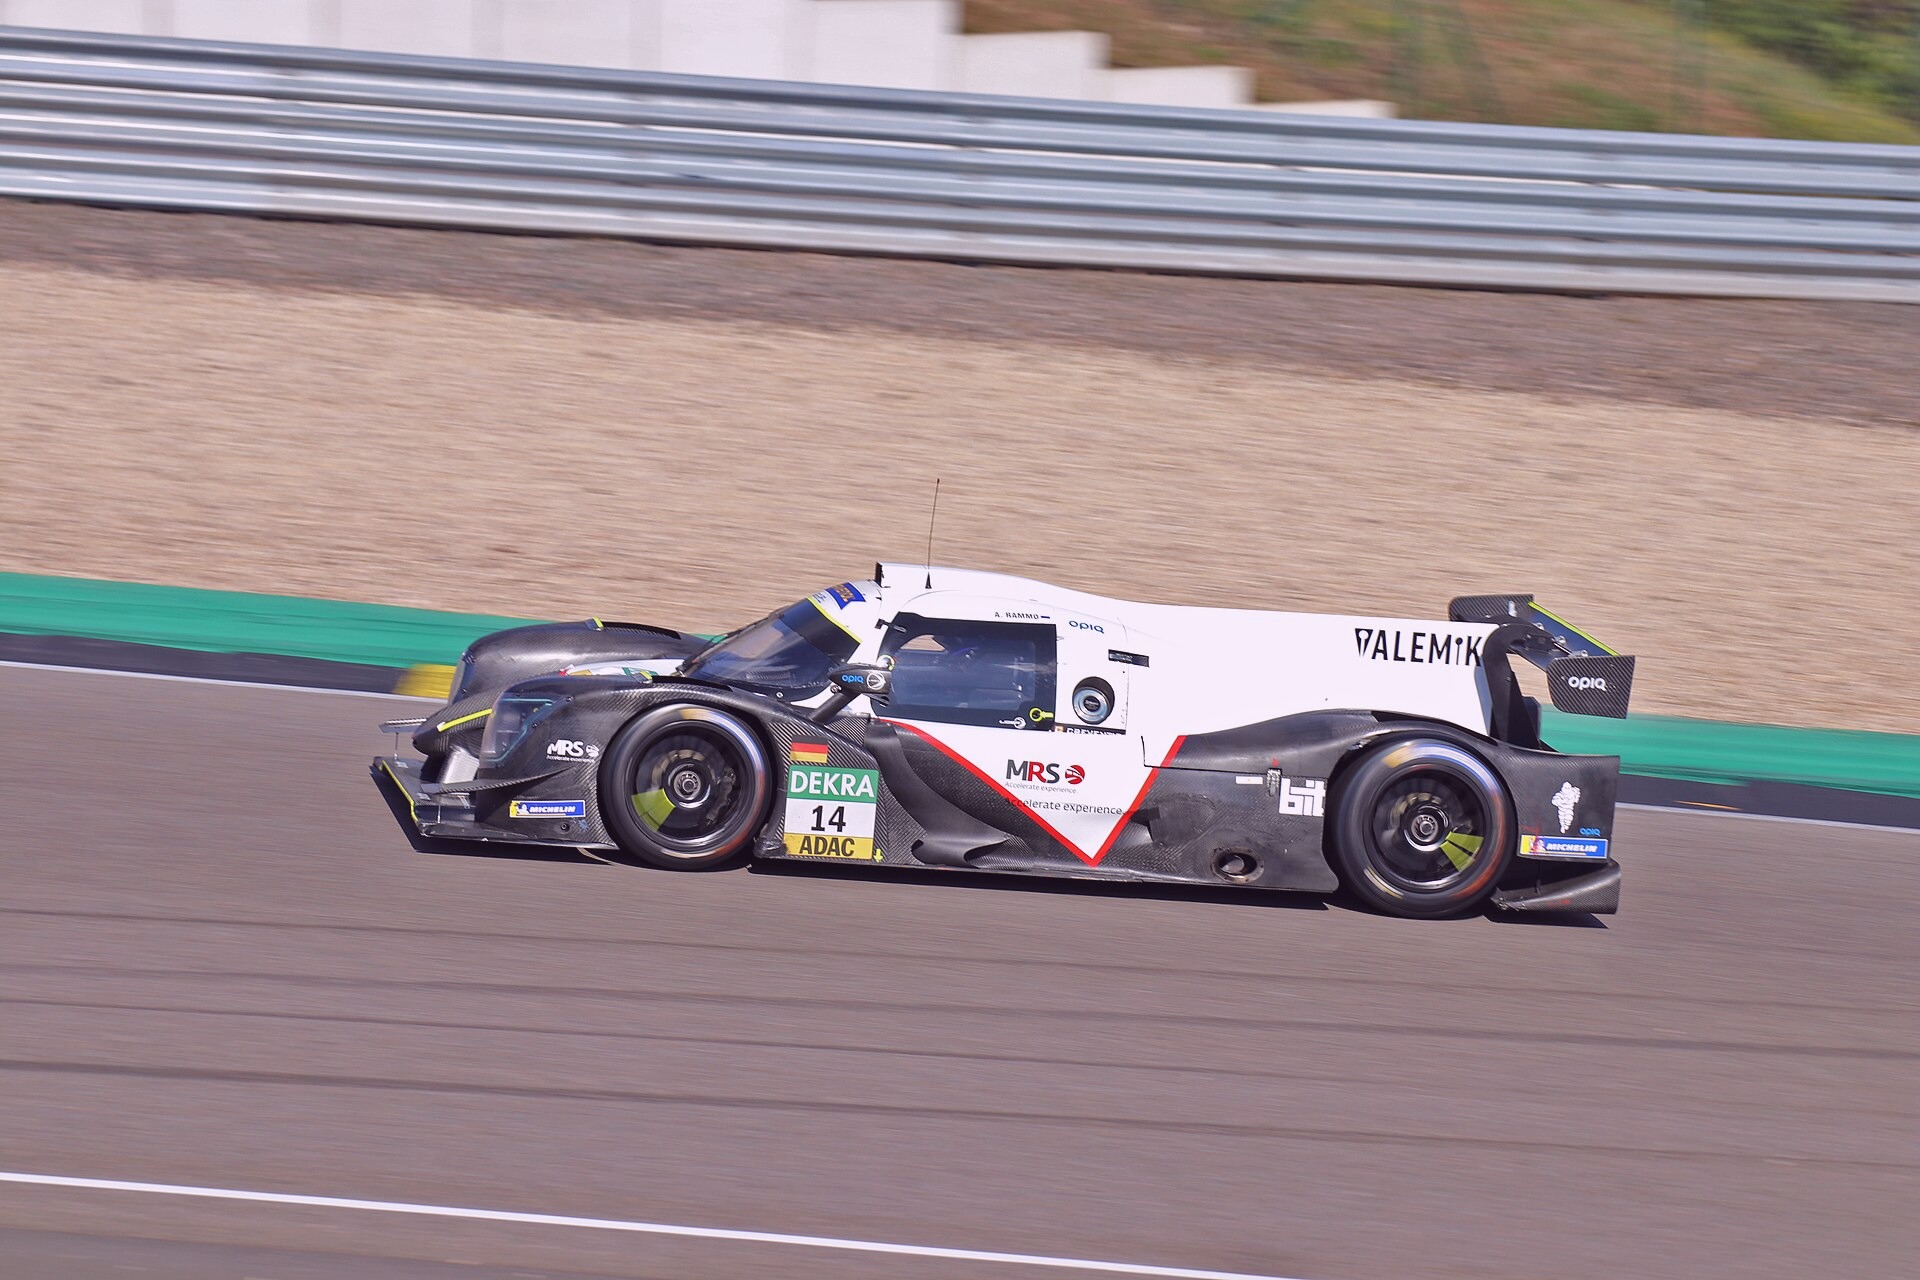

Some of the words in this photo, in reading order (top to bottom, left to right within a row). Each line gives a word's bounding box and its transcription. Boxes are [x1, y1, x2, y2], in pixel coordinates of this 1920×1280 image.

[546, 739, 584, 757] MRS
[1005, 759, 1060, 784] MRS
[790, 770, 875, 798] DEKRA
[1004, 781, 1040, 791] Accelerate
[529, 805, 576, 813] MICHELIN
[811, 805, 846, 832] 14
[799, 836, 855, 857] ADAC
[1546, 842, 1598, 853] MICHELIN
